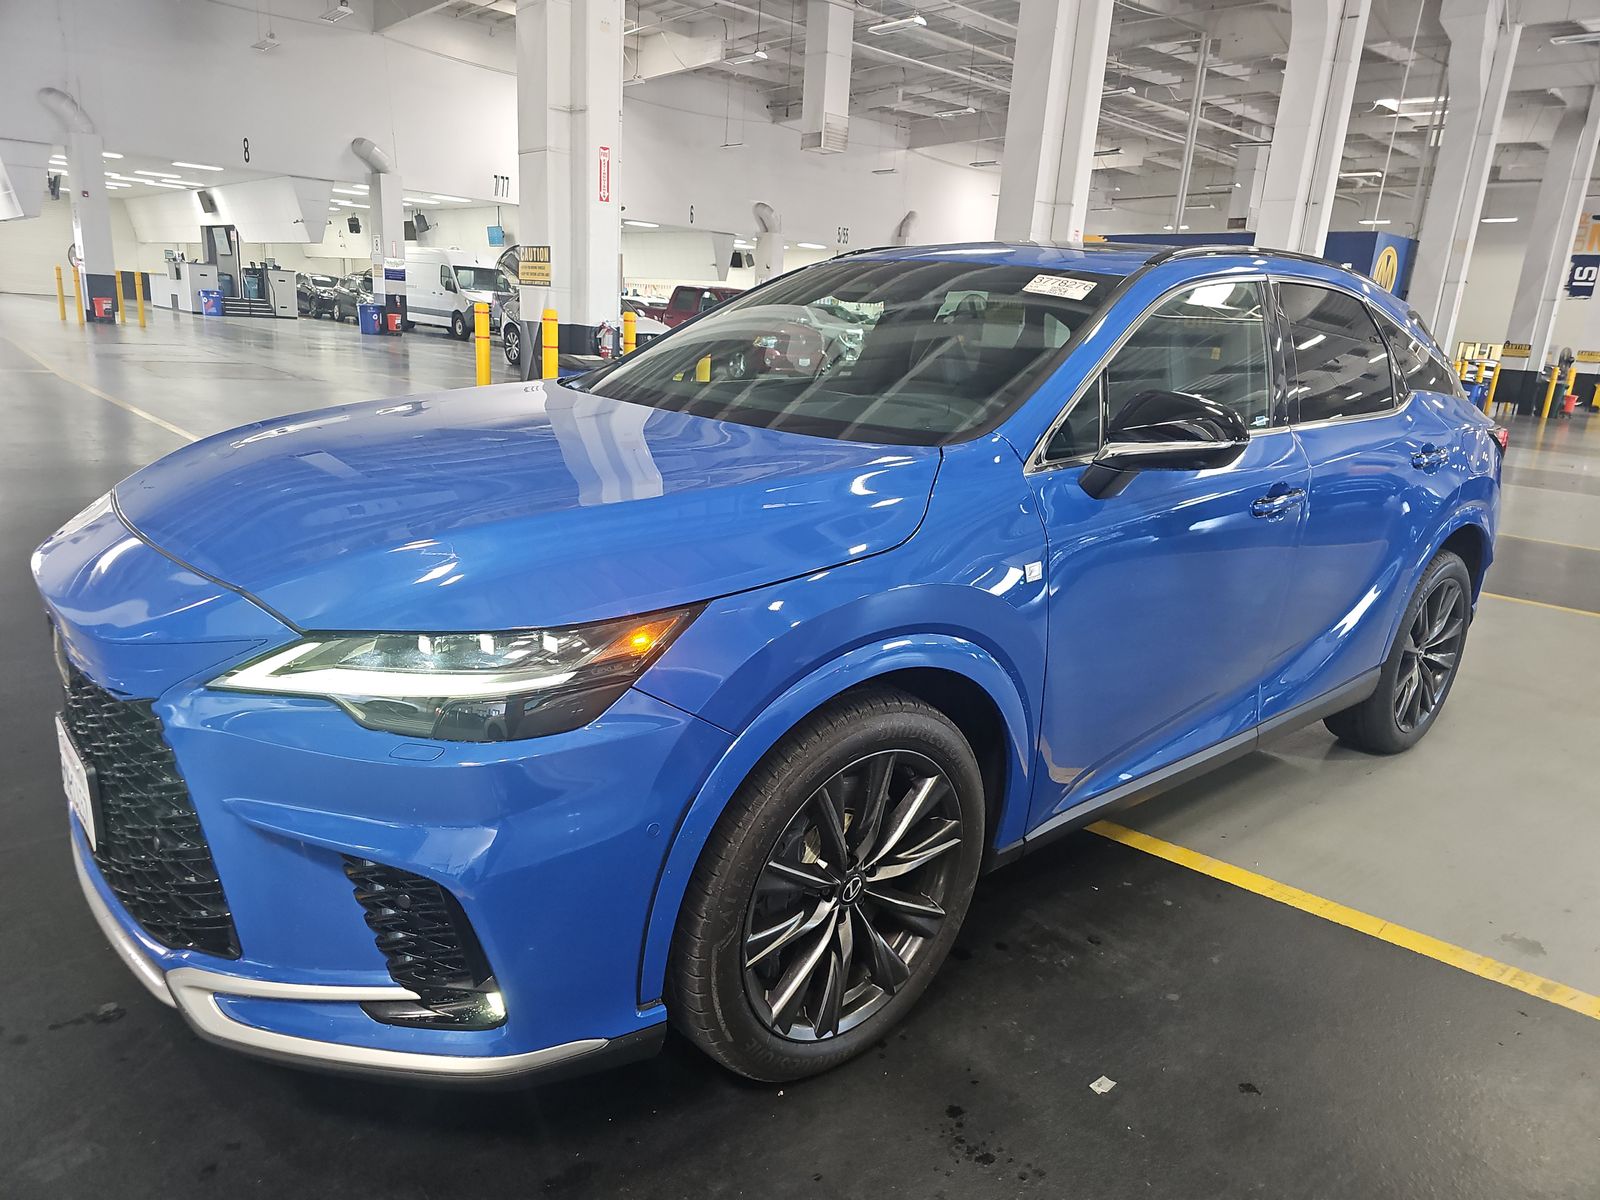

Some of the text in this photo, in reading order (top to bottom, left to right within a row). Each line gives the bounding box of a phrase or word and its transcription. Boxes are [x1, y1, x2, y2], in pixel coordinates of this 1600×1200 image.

[243, 137, 250, 163] 8
[689, 204, 695, 224] 6
[520, 247, 549, 262] CAUTION
[1033, 276, 1094, 291] 3778276
